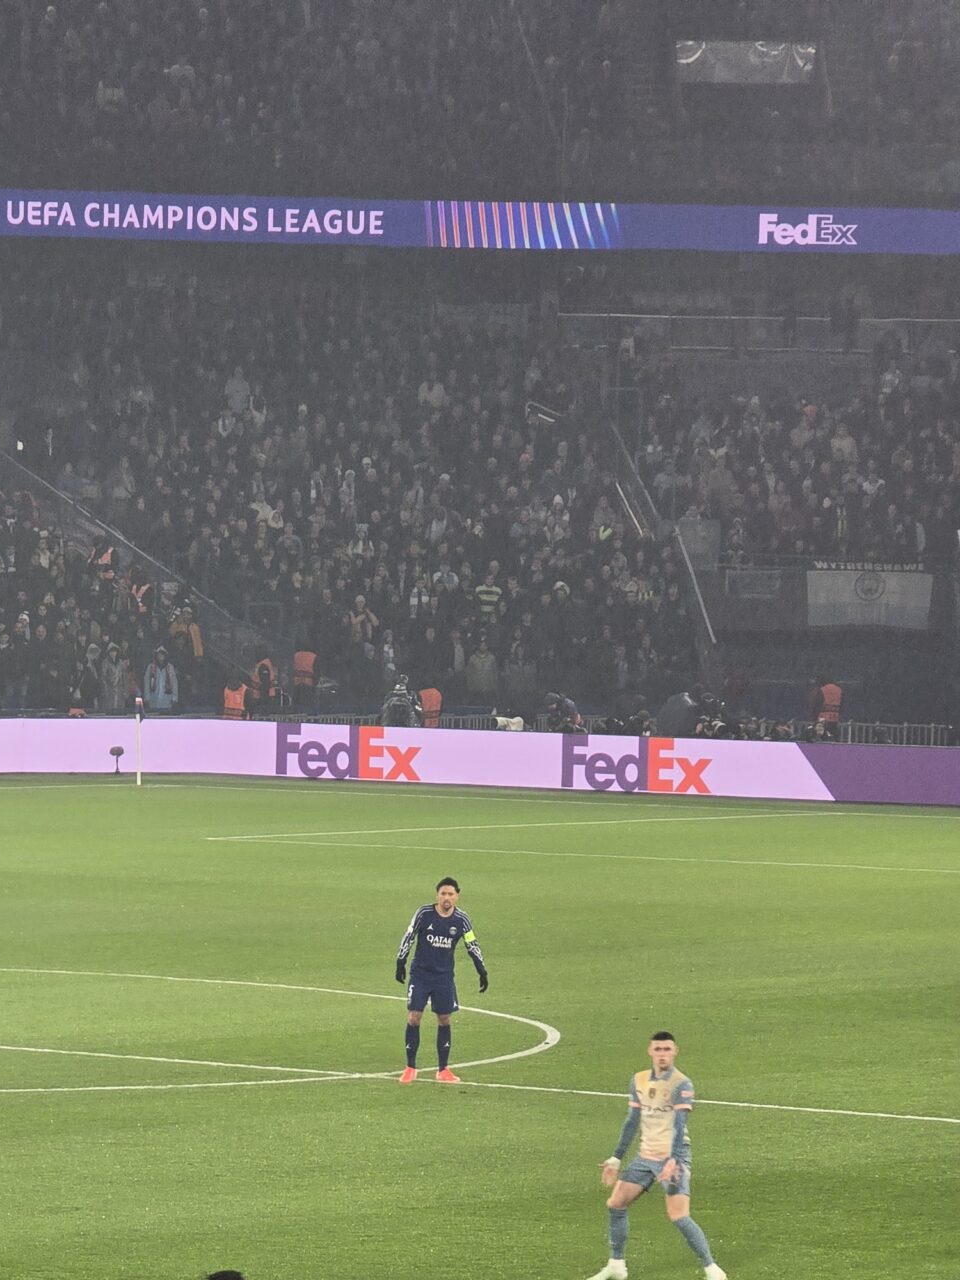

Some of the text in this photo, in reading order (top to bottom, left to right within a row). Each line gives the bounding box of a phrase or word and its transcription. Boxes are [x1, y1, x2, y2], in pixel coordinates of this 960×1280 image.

[6, 199, 384, 235] UEFA CHAMPIONS LEAGUE
[758, 213, 857, 245] FedEx
[276, 722, 421, 781] FedEx
[562, 735, 713, 794] FedEx
